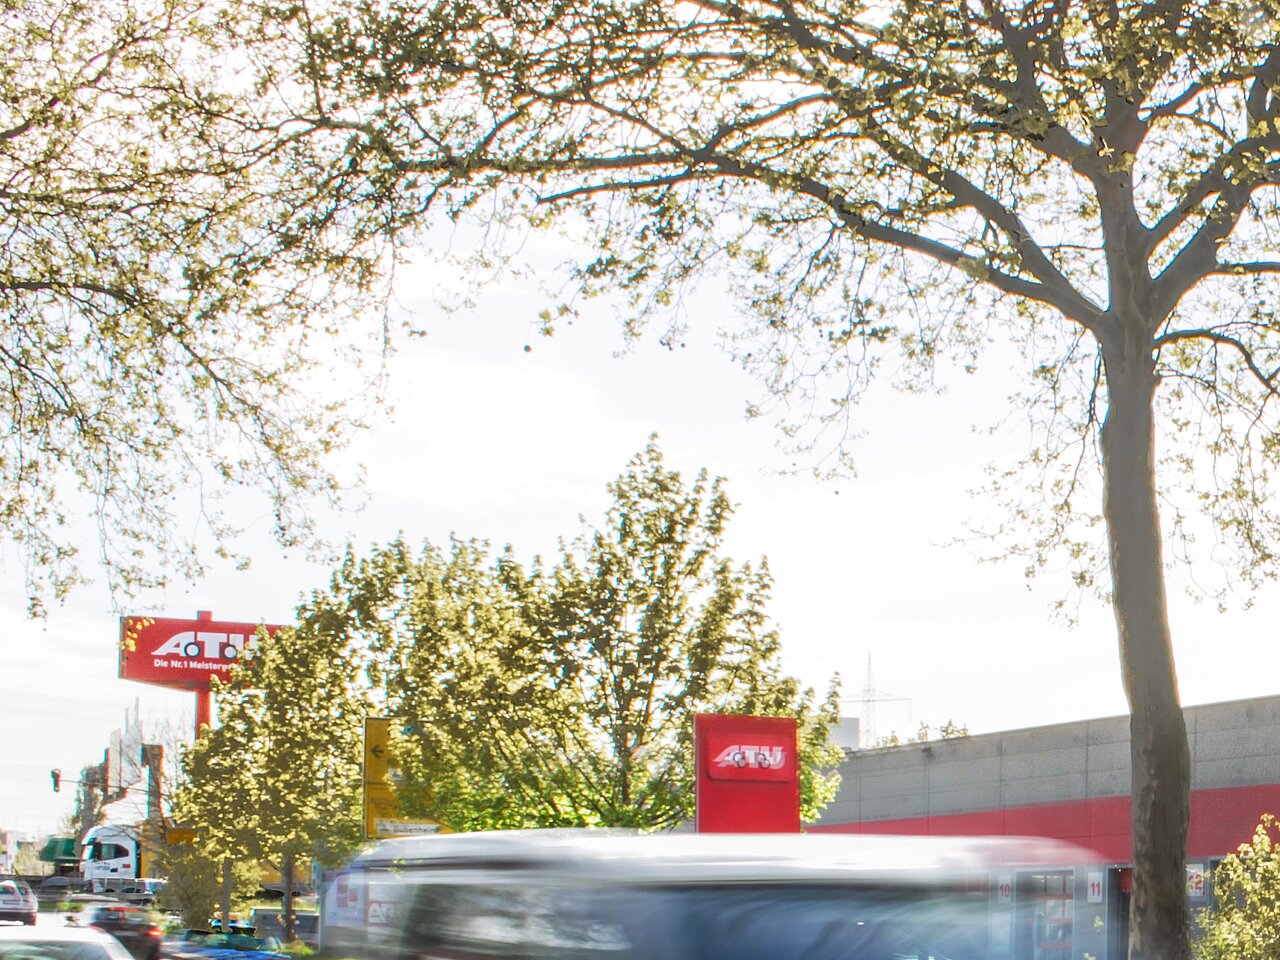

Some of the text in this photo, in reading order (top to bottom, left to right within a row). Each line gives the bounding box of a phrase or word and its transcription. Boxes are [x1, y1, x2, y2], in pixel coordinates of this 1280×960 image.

[153, 659, 169, 668] Die
[713, 745, 786, 769] ATU
[1090, 880, 1101, 897] 11
